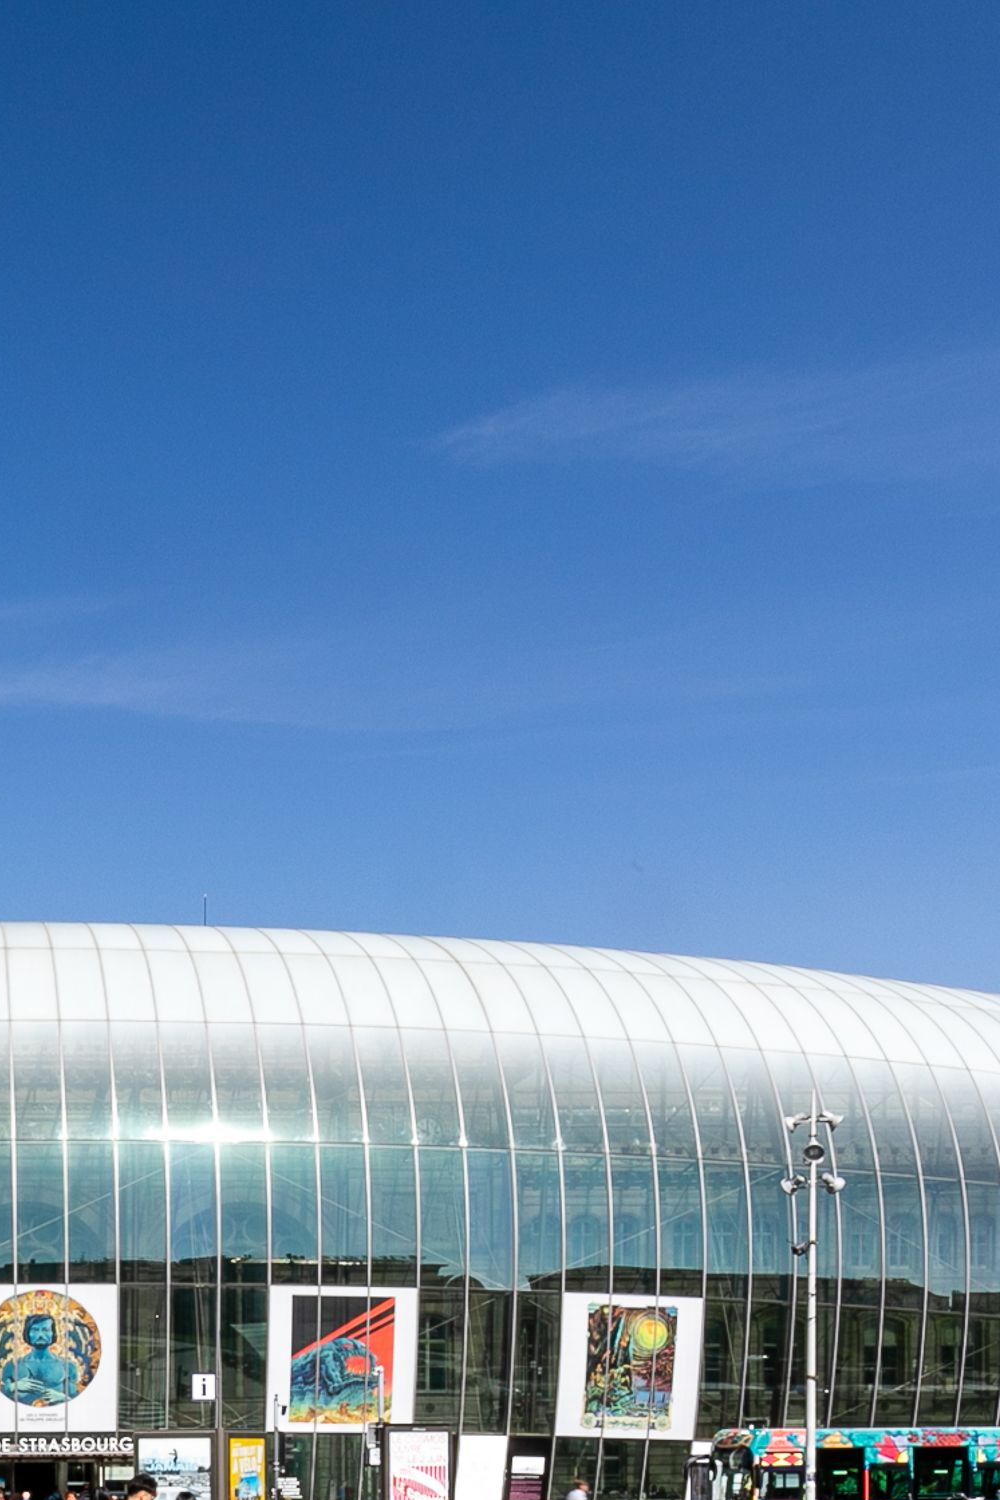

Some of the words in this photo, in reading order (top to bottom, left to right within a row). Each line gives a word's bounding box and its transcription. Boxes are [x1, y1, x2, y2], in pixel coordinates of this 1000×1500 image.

[18, 1436, 134, 1453] STRASBOURG
[392, 1434, 402, 1444] LE
[405, 1434, 446, 1444] COSMOS
